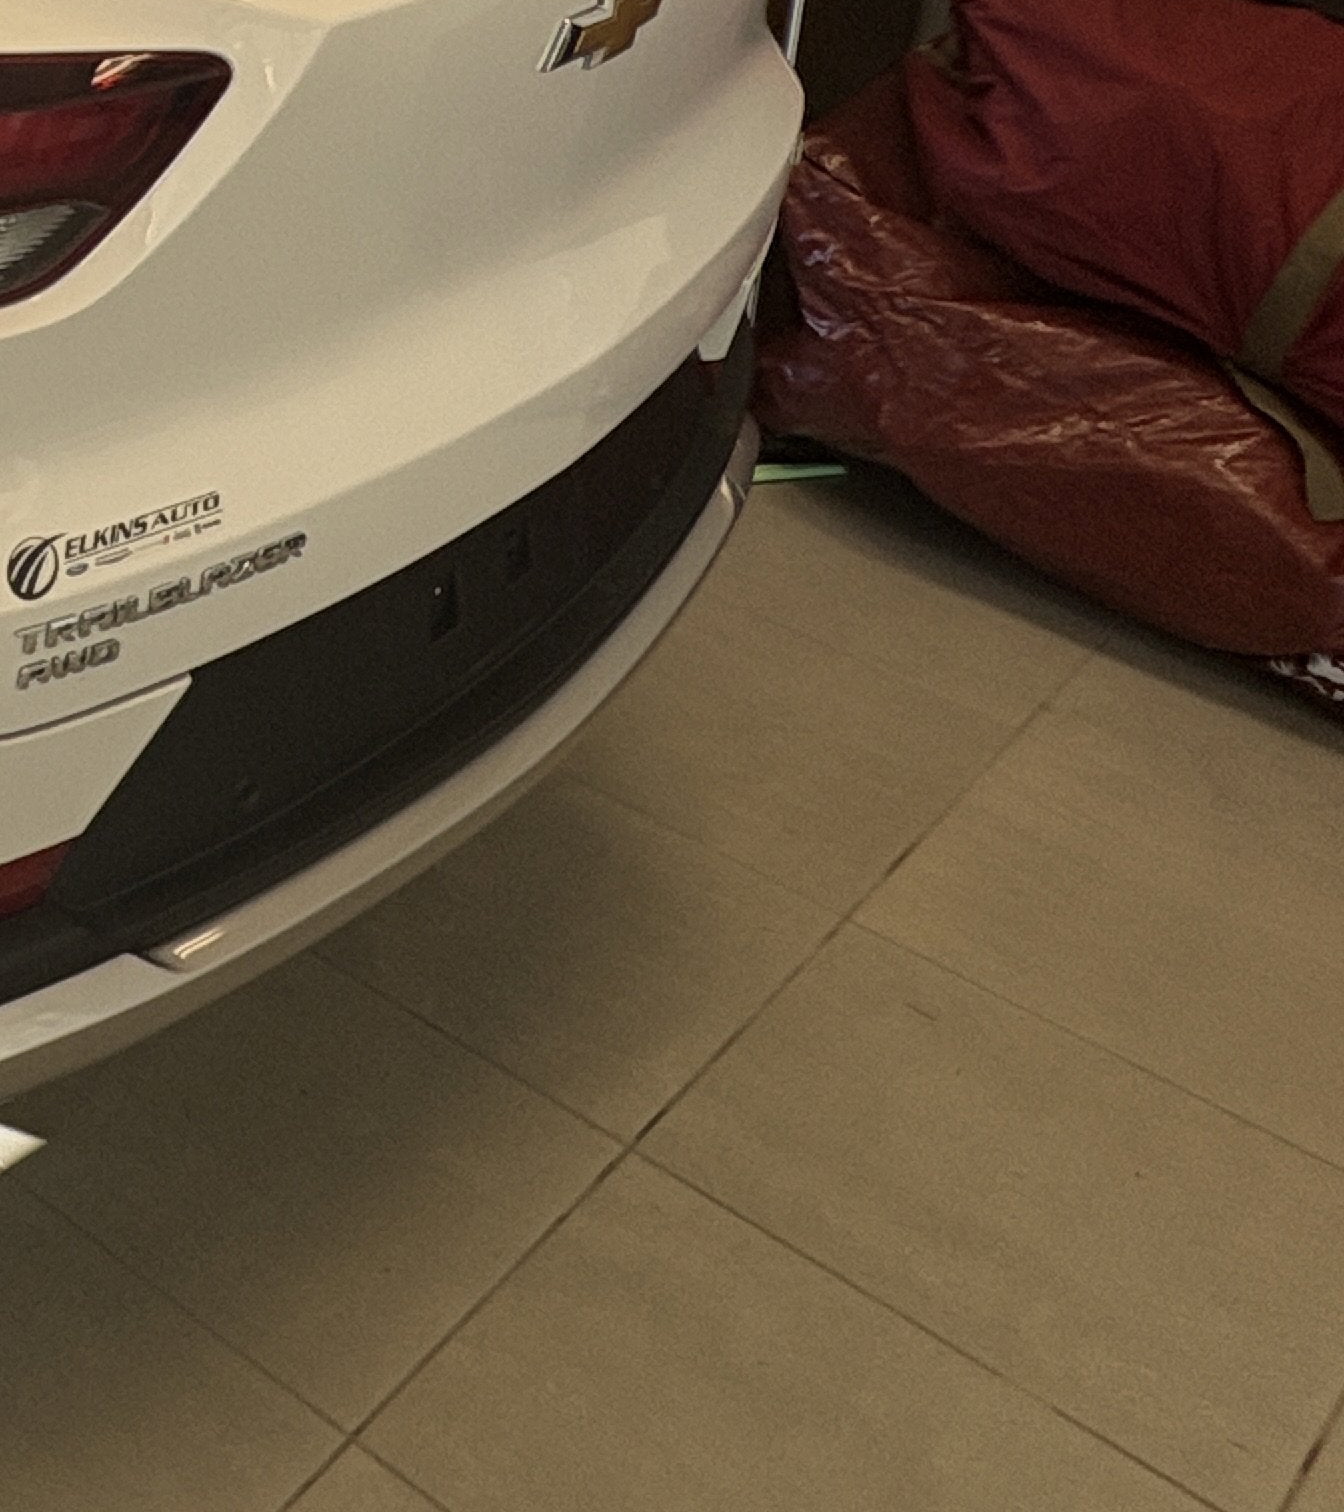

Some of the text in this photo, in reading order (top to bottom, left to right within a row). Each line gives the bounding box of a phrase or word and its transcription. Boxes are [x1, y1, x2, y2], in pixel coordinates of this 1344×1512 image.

[65, 516, 149, 560] ELKINS
[150, 492, 220, 530] AUTO
[14, 530, 307, 655] TRAILBLAZER
[16, 637, 121, 690] AWD
